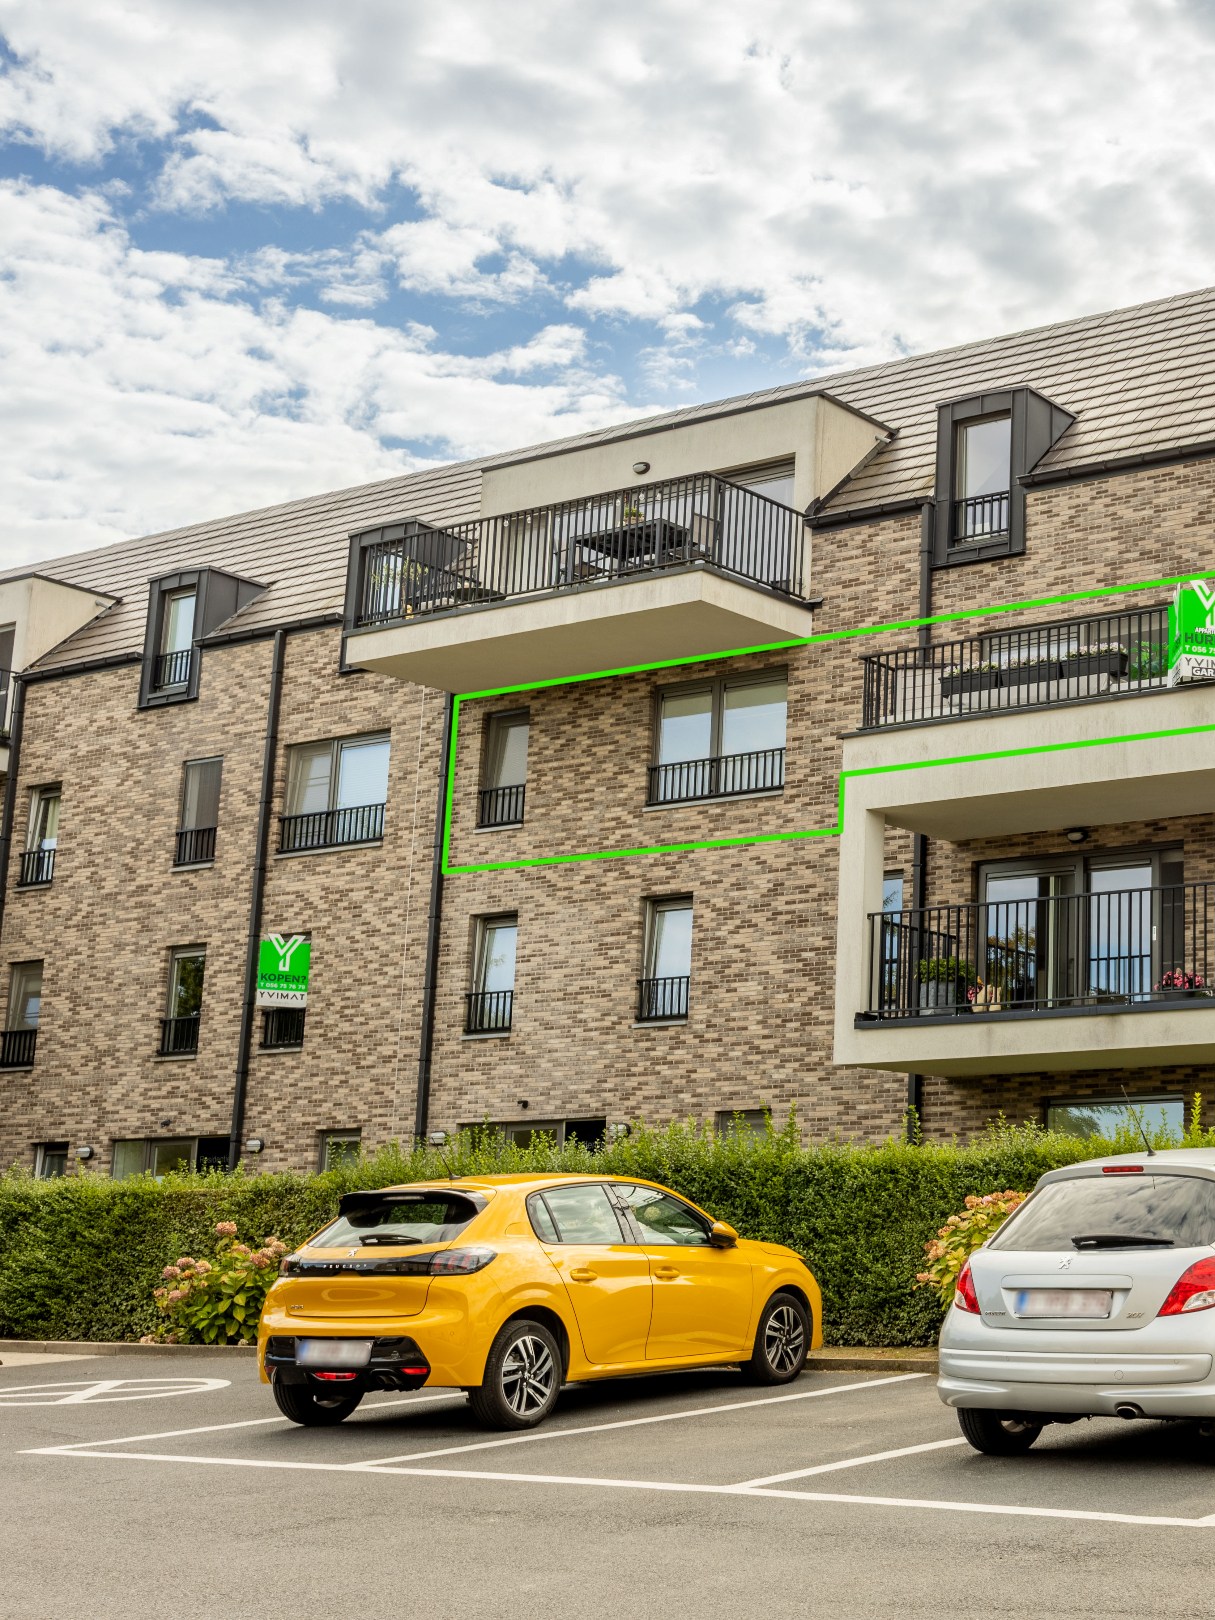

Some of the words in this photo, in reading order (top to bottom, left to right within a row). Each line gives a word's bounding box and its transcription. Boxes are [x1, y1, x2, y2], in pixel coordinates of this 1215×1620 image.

[1192, 645, 1207, 653] 056
[260, 972, 306, 983] KOPEN?
[259, 991, 305, 1000] YVIMAT
